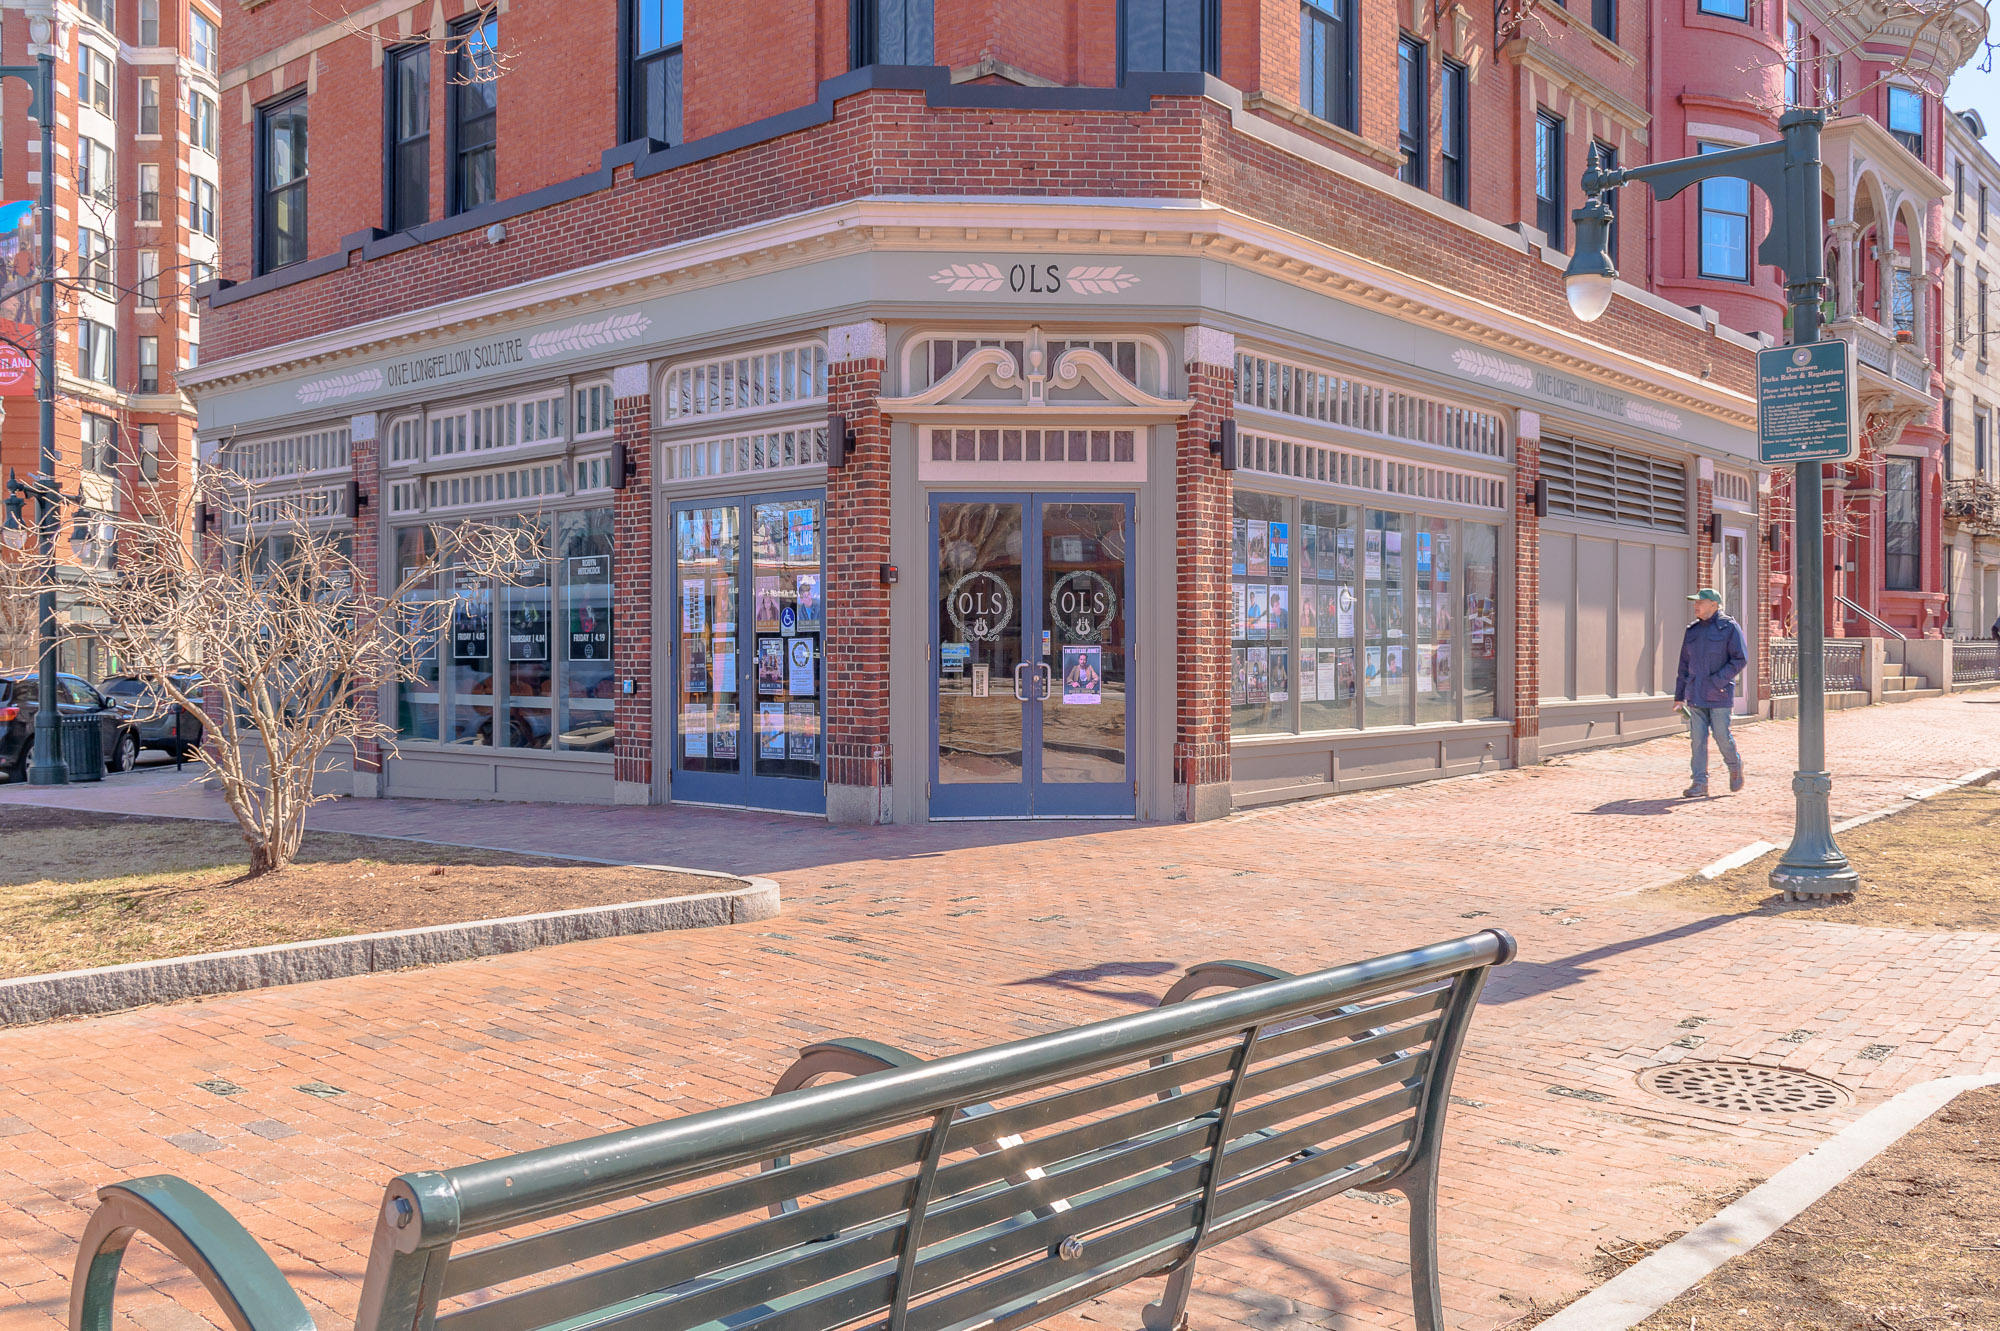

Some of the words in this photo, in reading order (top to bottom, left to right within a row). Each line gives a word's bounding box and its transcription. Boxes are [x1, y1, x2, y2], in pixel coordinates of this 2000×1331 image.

[1009, 264, 1061, 293] OLS
[387, 363, 409, 387] ONE
[410, 348, 472, 383] LONGFELLOW
[474, 338, 524, 370] SQUARE
[1786, 365, 1818, 373] Downtown
[1808, 369, 1843, 378] Regulations
[1535, 372, 1553, 397] ONE
[1553, 376, 1595, 407] LONGFELLOW
[1596, 389, 1625, 417] SQUARE
[958, 592, 1002, 615] OLS
[1061, 591, 1105, 614] OLS
[573, 633, 589, 642] FRIDAY
